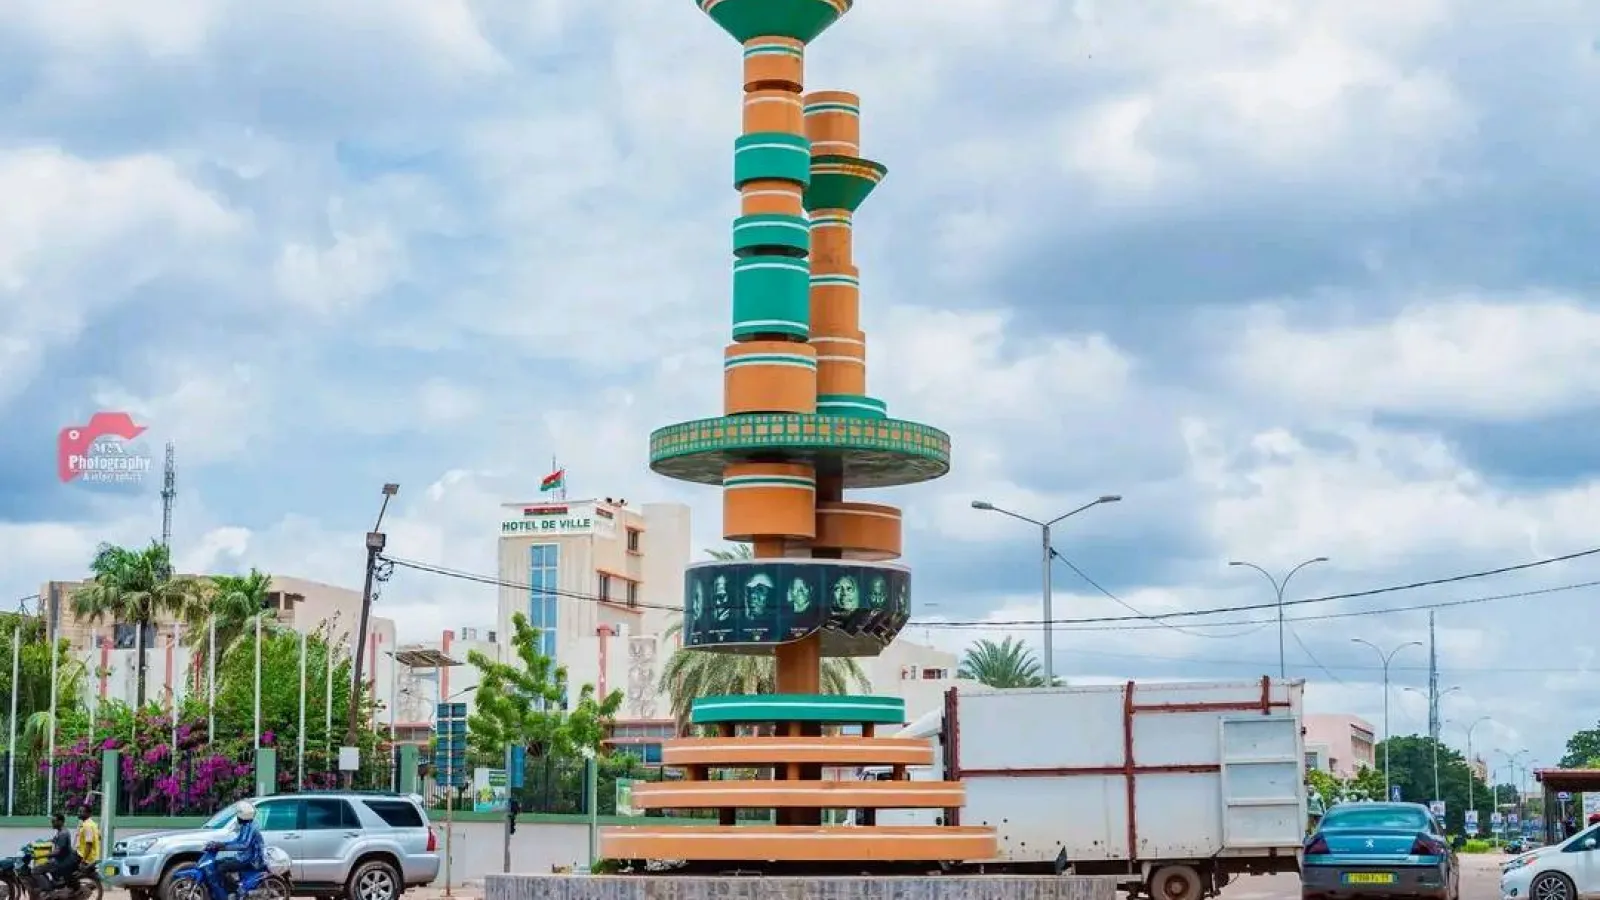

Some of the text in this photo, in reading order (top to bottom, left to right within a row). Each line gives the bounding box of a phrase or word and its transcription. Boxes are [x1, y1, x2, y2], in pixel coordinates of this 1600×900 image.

[502, 521, 538, 531] HOTEL
[541, 520, 556, 529] DE
[559, 519, 591, 529] VILLE
